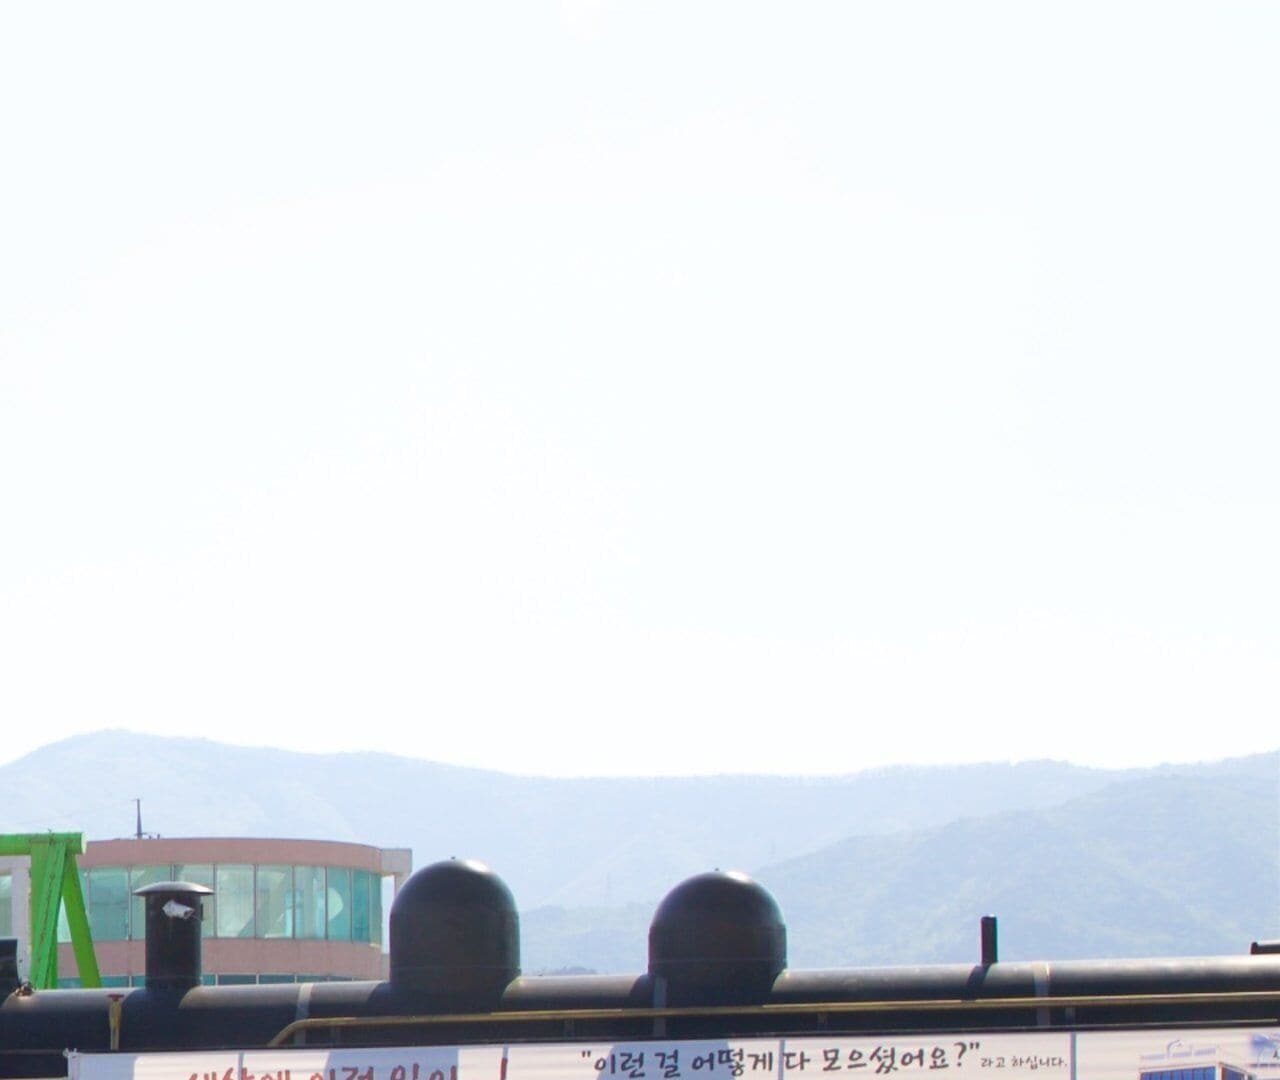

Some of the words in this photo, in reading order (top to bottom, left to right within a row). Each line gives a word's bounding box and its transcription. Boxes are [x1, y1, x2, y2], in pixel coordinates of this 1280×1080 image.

[581, 1050, 646, 1078] "이런
[654, 1049, 681, 1079] 걸
[691, 1047, 774, 1077] 어떻게
[783, 1050, 811, 1071] 다
[822, 1041, 980, 1074] 모으셨어요?"
[980, 1056, 1006, 1069] 라고
[1011, 1055, 1068, 1070] 하십니다.
